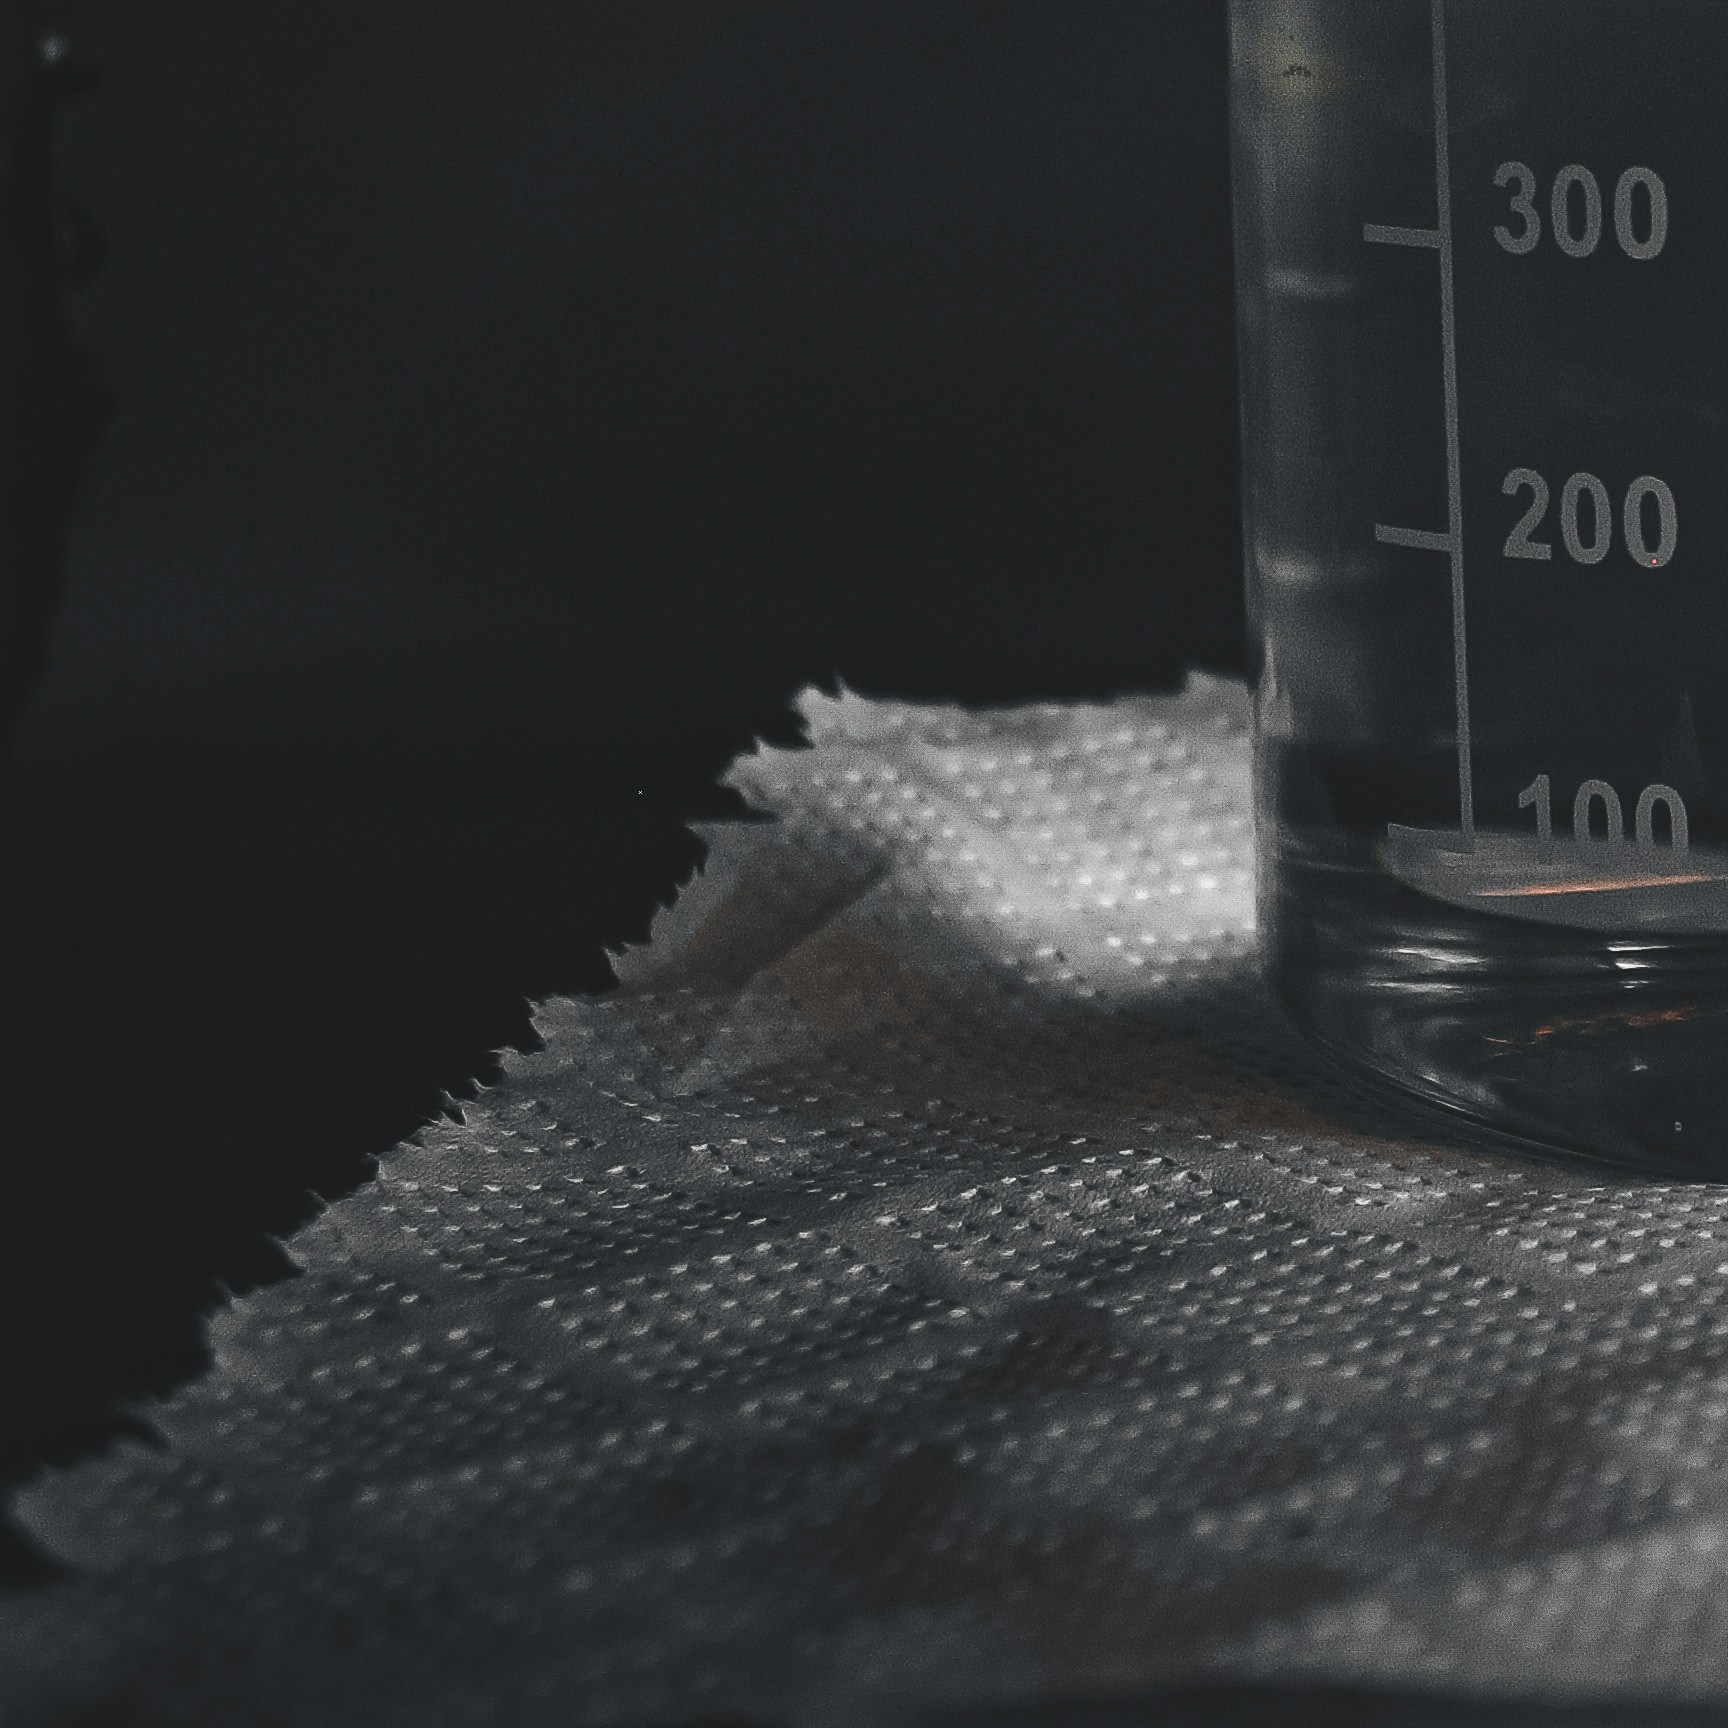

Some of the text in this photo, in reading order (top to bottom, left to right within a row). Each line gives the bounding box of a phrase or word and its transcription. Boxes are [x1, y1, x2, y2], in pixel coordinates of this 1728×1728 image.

[1490, 160, 1670, 260] 300
[1500, 467, 1679, 570] 200
[1517, 773, 1690, 866] 100
